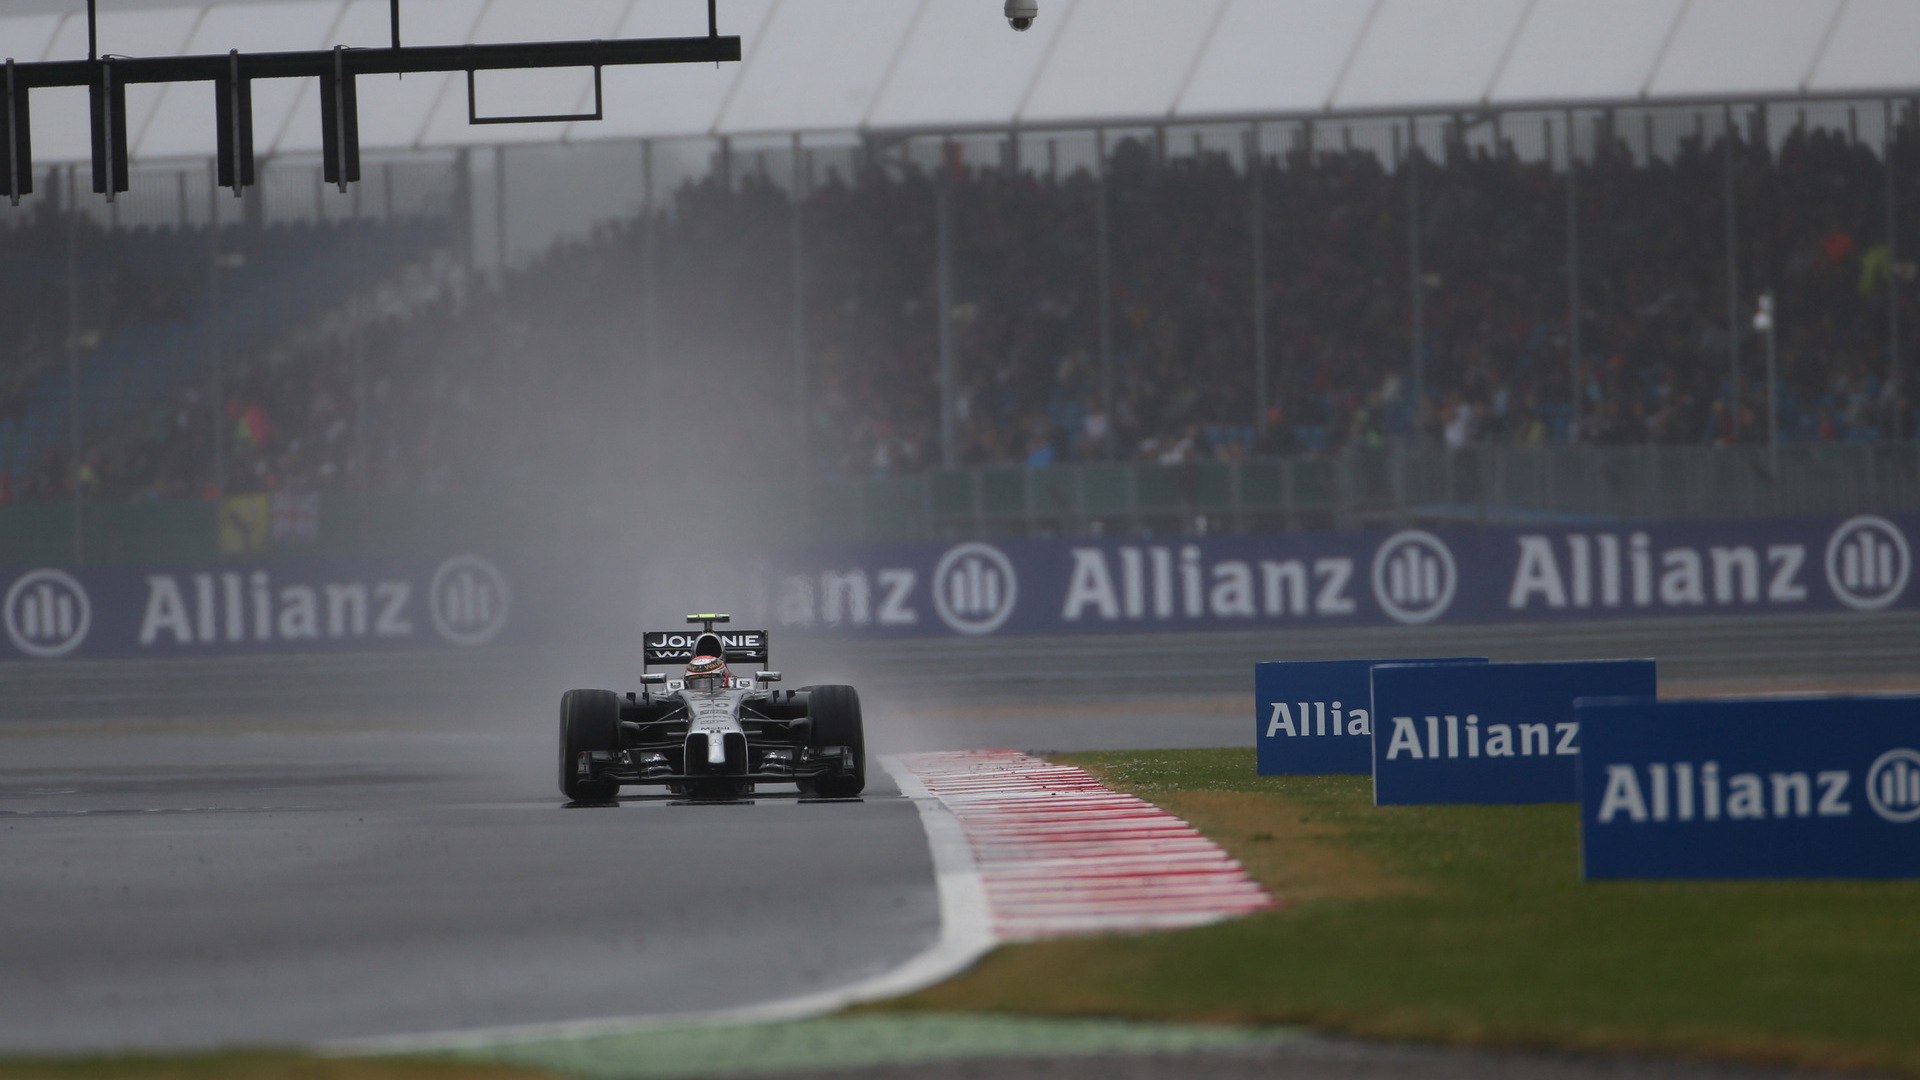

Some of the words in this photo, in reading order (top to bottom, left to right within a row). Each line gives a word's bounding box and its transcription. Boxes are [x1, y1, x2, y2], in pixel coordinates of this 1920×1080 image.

[1061, 546, 1356, 621] Allianz
[1508, 532, 1806, 608] Allianz
[138, 570, 412, 645] Allianz
[652, 634, 759, 647] JOHNIE
[1386, 714, 1580, 760] Allianz
[1599, 761, 1850, 823] Allianz
